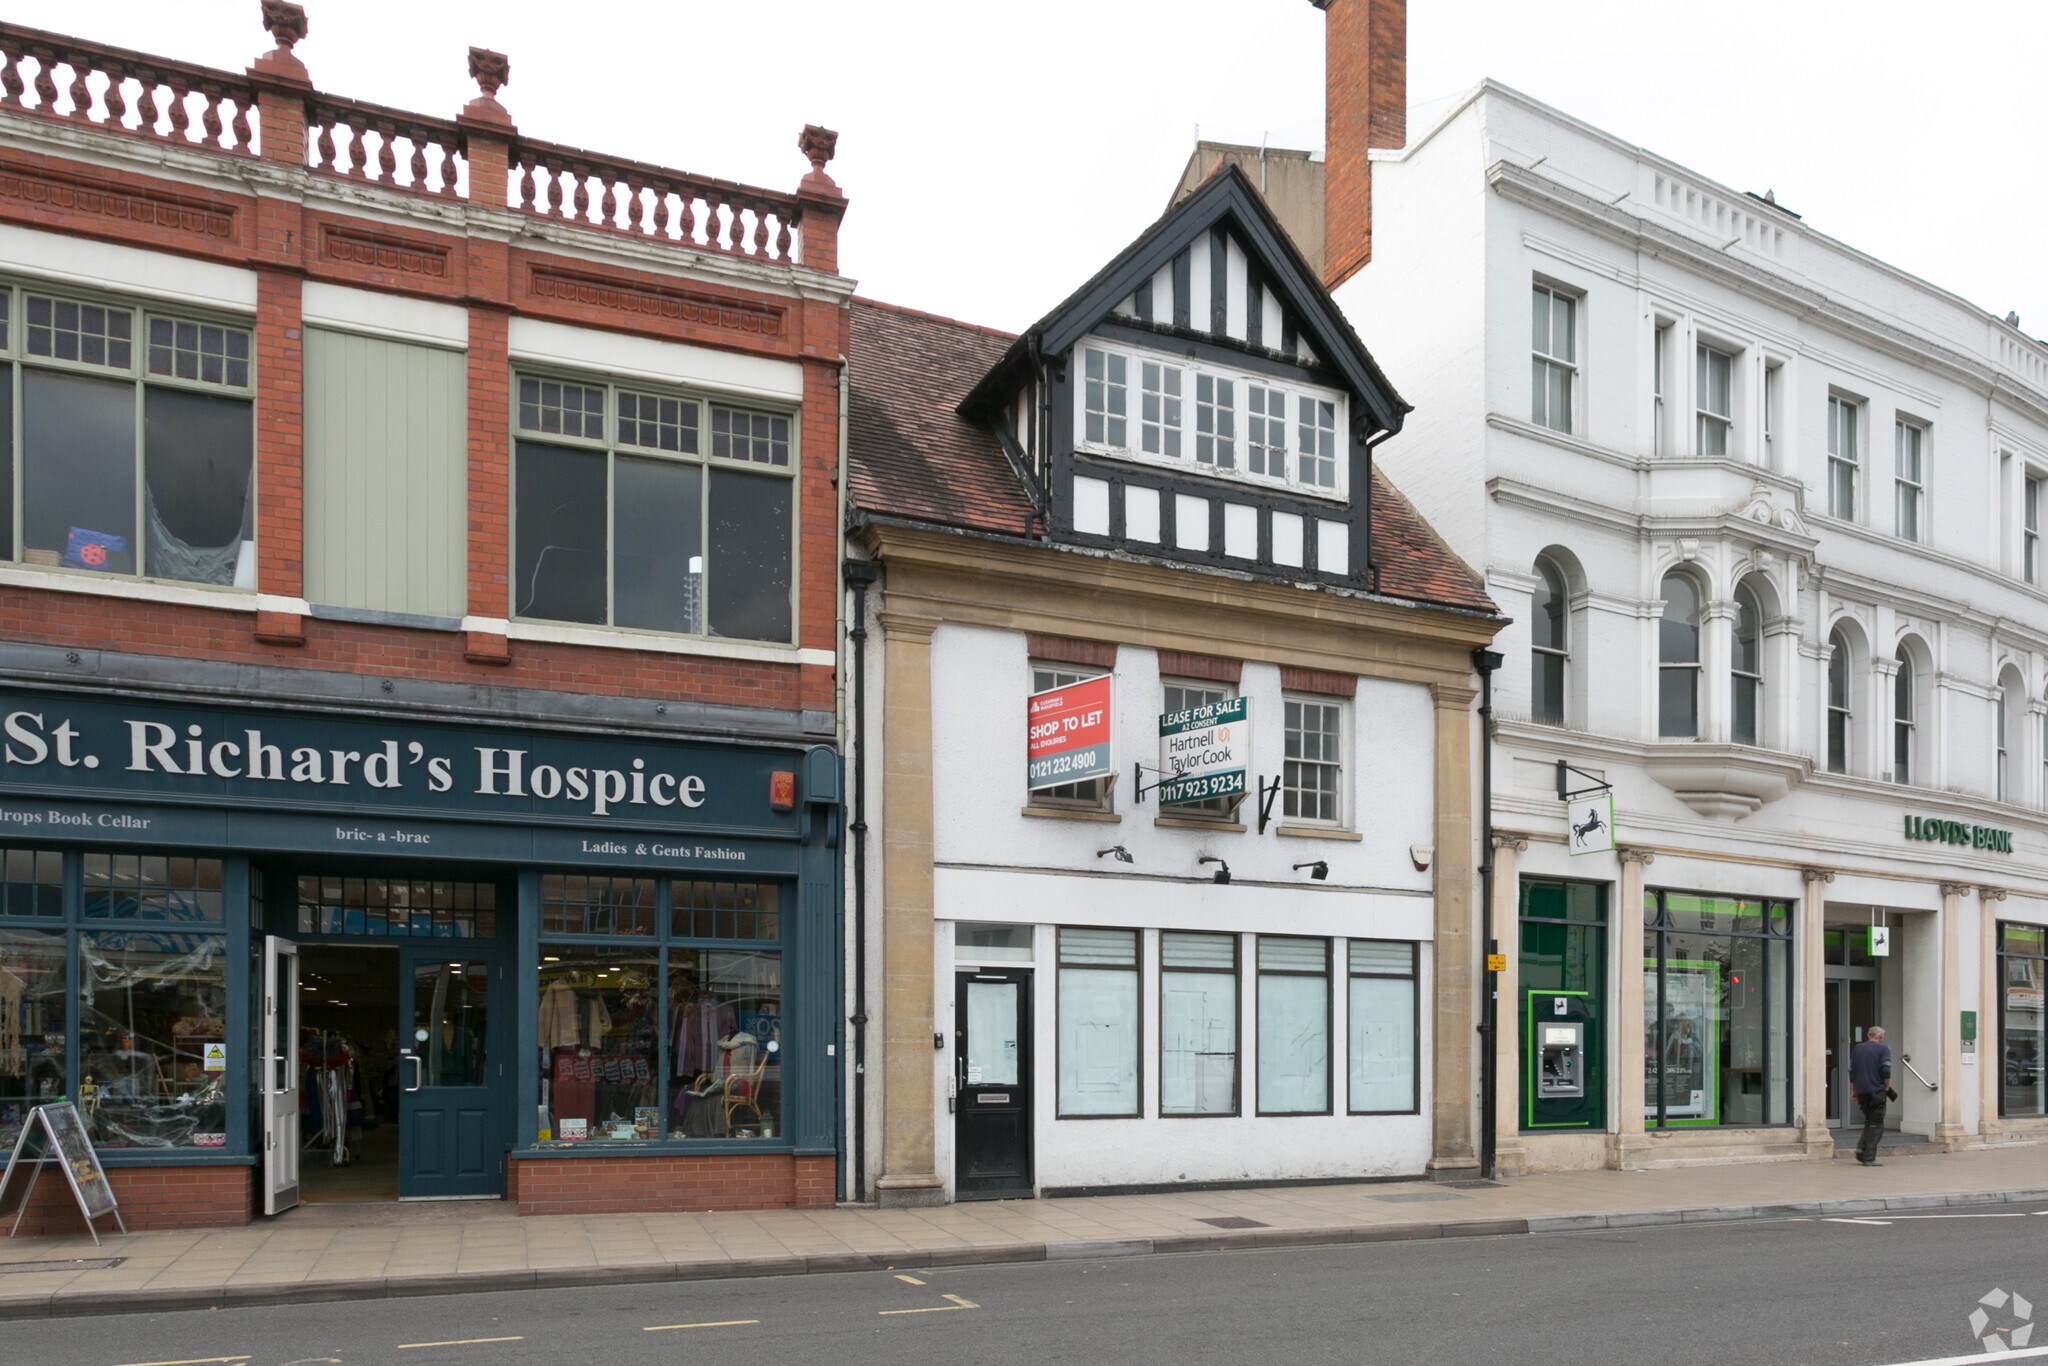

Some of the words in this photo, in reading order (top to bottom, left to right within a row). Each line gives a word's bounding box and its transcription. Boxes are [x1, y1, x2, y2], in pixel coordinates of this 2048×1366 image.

[1030, 721, 1059, 740] SHOP
[1062, 716, 1078, 732] TO
[1081, 711, 1103, 727] LET
[1162, 710, 1191, 727] LEASE
[1193, 705, 1214, 721] FOR
[1216, 699, 1241, 715] SALE
[1181, 724, 1190, 732] A2
[1191, 717, 1218, 729] CONSENT
[1040, 736, 1067, 748] ENQUIRIES
[1170, 729, 1214, 753] Hartnell
[3, 711, 99, 768] St.
[124, 719, 453, 794] Richard's
[474, 746, 707, 816] Hospice
[1030, 760, 1051, 779] 0121
[1053, 756, 1071, 774] 232
[1072, 751, 1096, 769] 4900
[1169, 754, 1202, 772] Taylor
[1203, 746, 1232, 765] Cook
[1160, 783, 1184, 802] 0117
[1185, 779, 1208, 798] 923
[1211, 774, 1242, 794] 9234
[48, 811, 93, 827] Book
[98, 813, 151, 829] Cellar
[1904, 815, 1972, 845] LLOYDS
[1973, 825, 2014, 853] BANK
[582, 840, 627, 855] Ladies
[635, 843, 648, 856] &
[652, 843, 691, 858] Gents
[695, 846, 746, 861] Fashion
